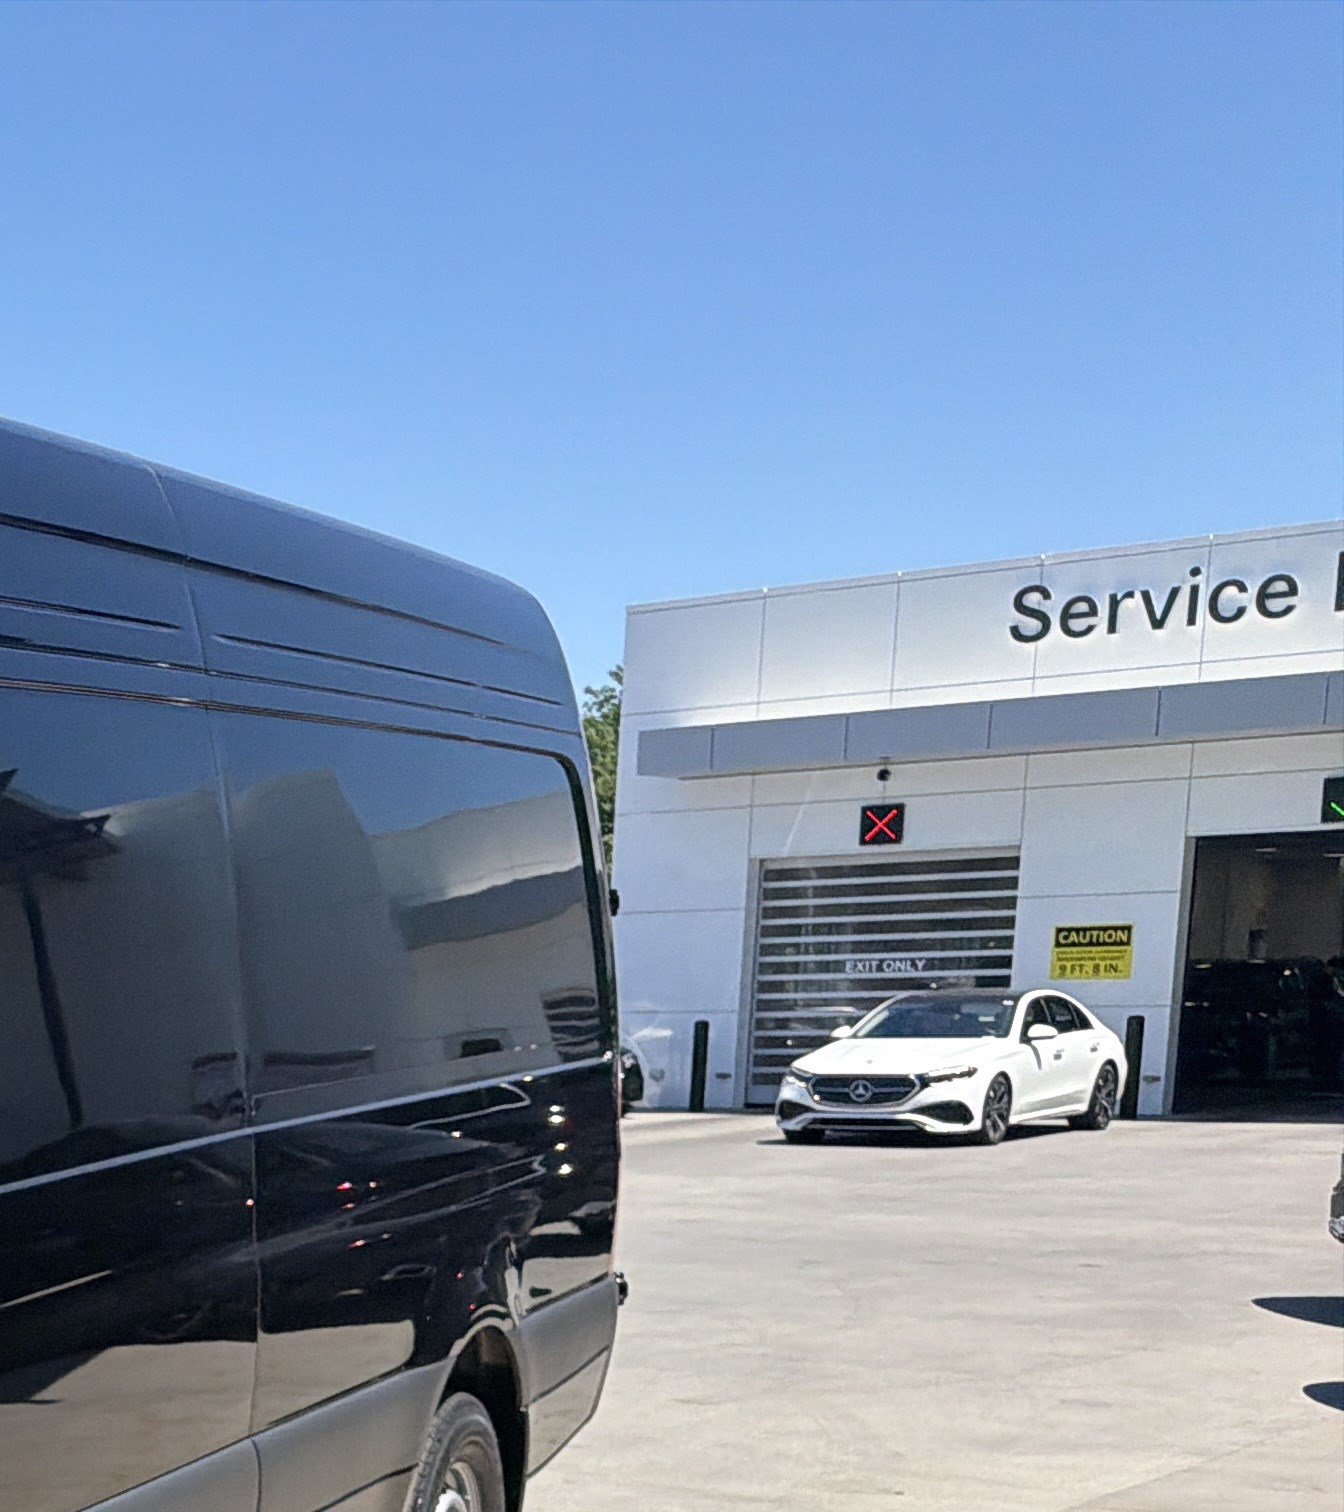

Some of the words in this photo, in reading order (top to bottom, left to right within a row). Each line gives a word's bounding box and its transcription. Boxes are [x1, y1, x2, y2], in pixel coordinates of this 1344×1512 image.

[1009, 566, 1299, 643] Service
[1058, 930, 1128, 944] CAUTION
[845, 960, 880, 974] EXIT
[883, 959, 926, 973] ONLY
